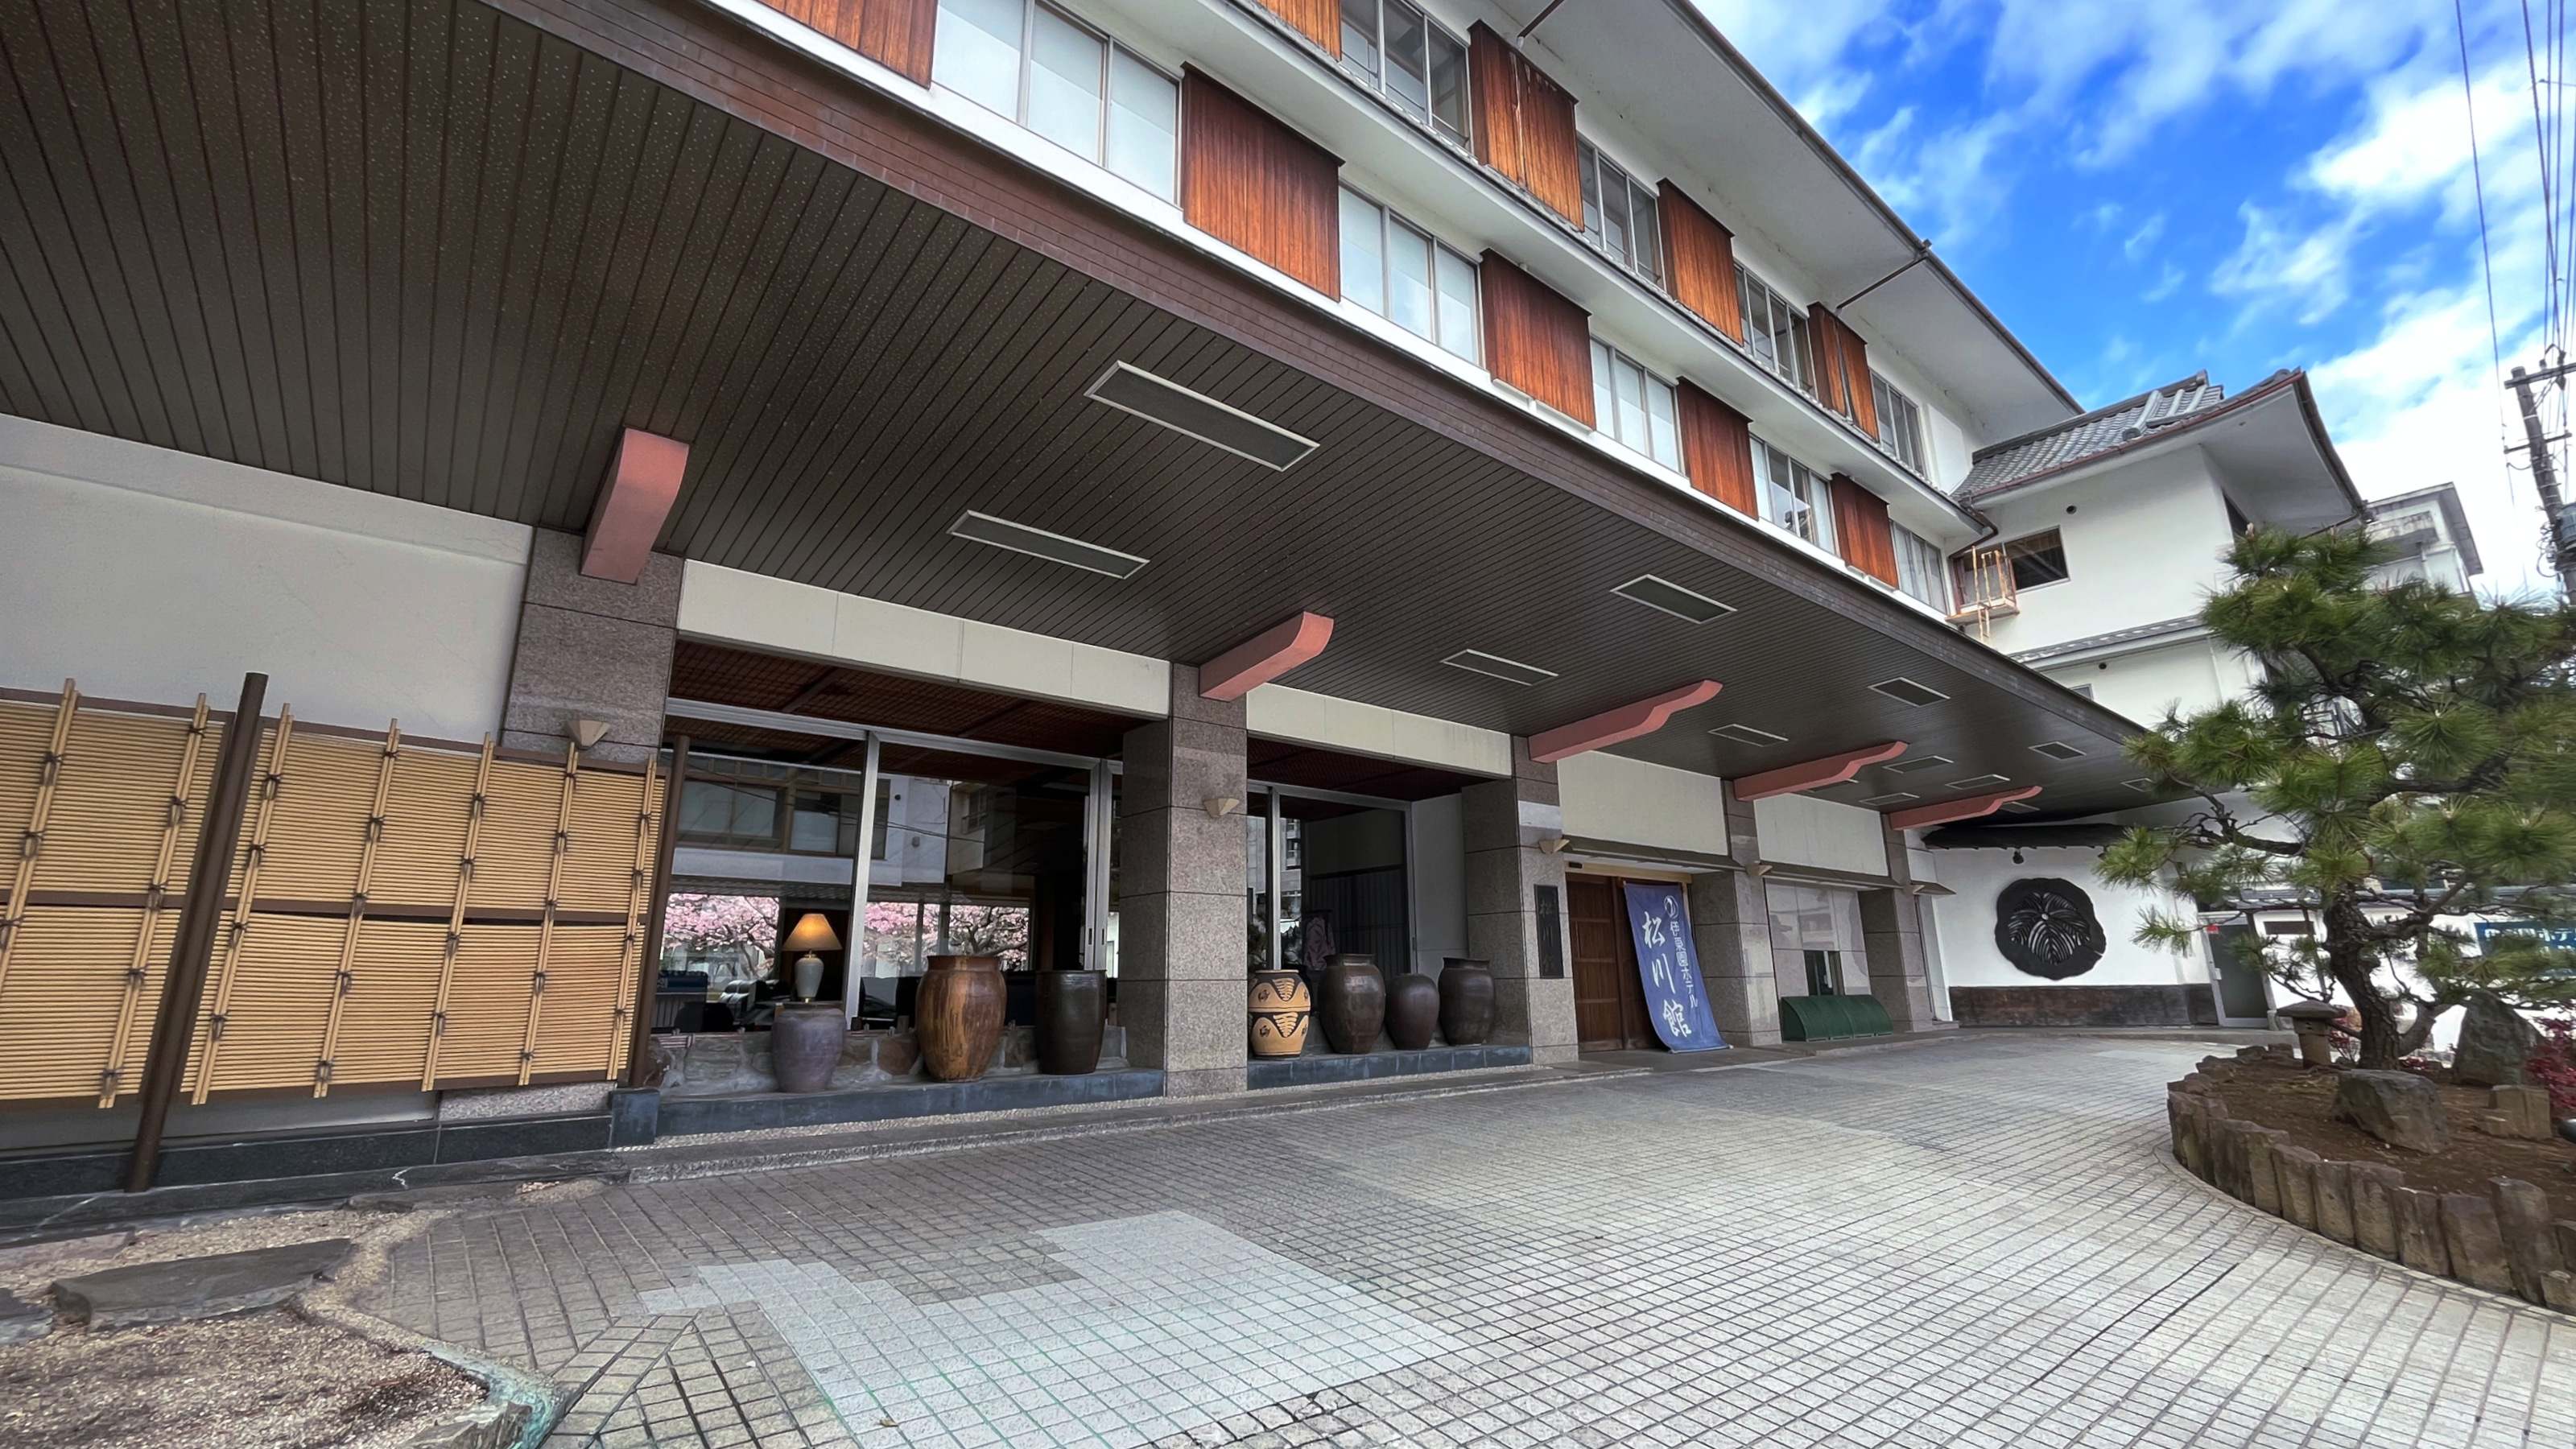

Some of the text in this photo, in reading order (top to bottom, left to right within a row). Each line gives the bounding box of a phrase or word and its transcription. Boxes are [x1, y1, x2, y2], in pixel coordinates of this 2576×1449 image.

[1642, 911, 1691, 1037] 松川館
[1670, 921, 1699, 1009] 伊東園ホテル
